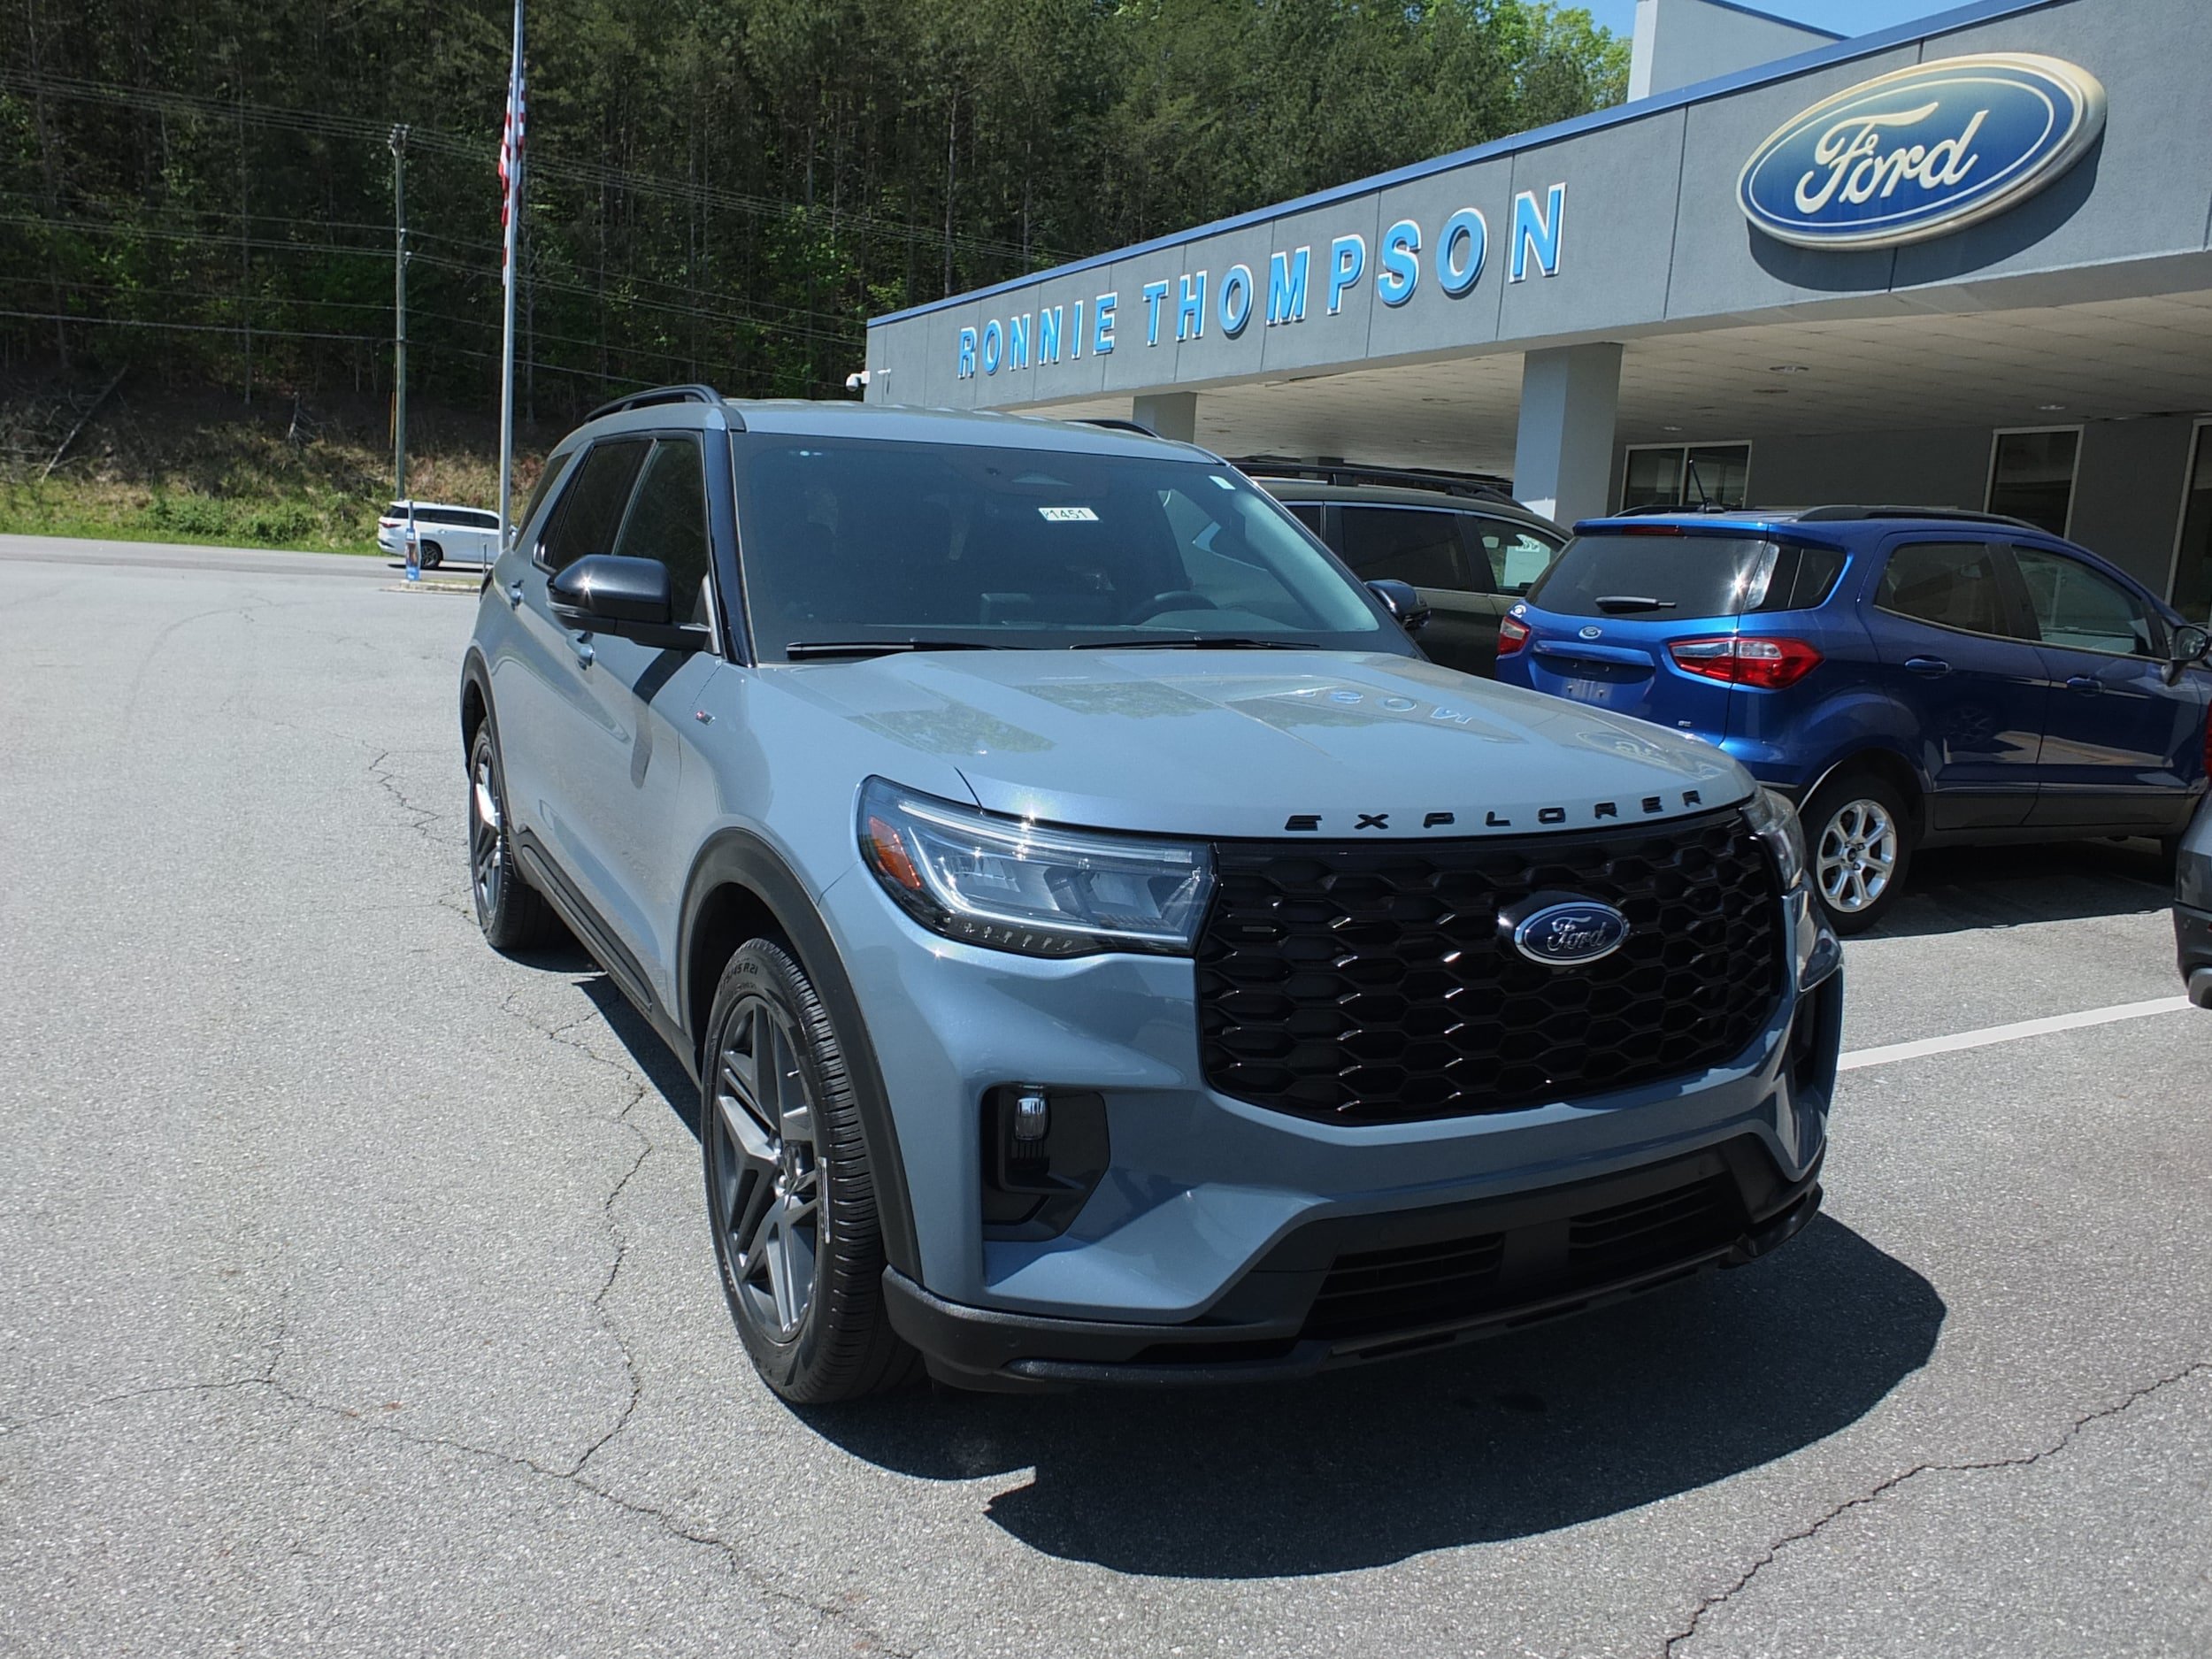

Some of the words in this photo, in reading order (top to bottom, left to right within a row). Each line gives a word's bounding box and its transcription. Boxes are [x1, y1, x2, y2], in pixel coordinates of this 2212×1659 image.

[1794, 101, 1989, 215] Ford
[957, 291, 1118, 379] RONNIE
[1142, 181, 1566, 346] THOMPSON
[1284, 789, 1701, 832] EXPLORER
[1546, 916, 1608, 952] Ford
